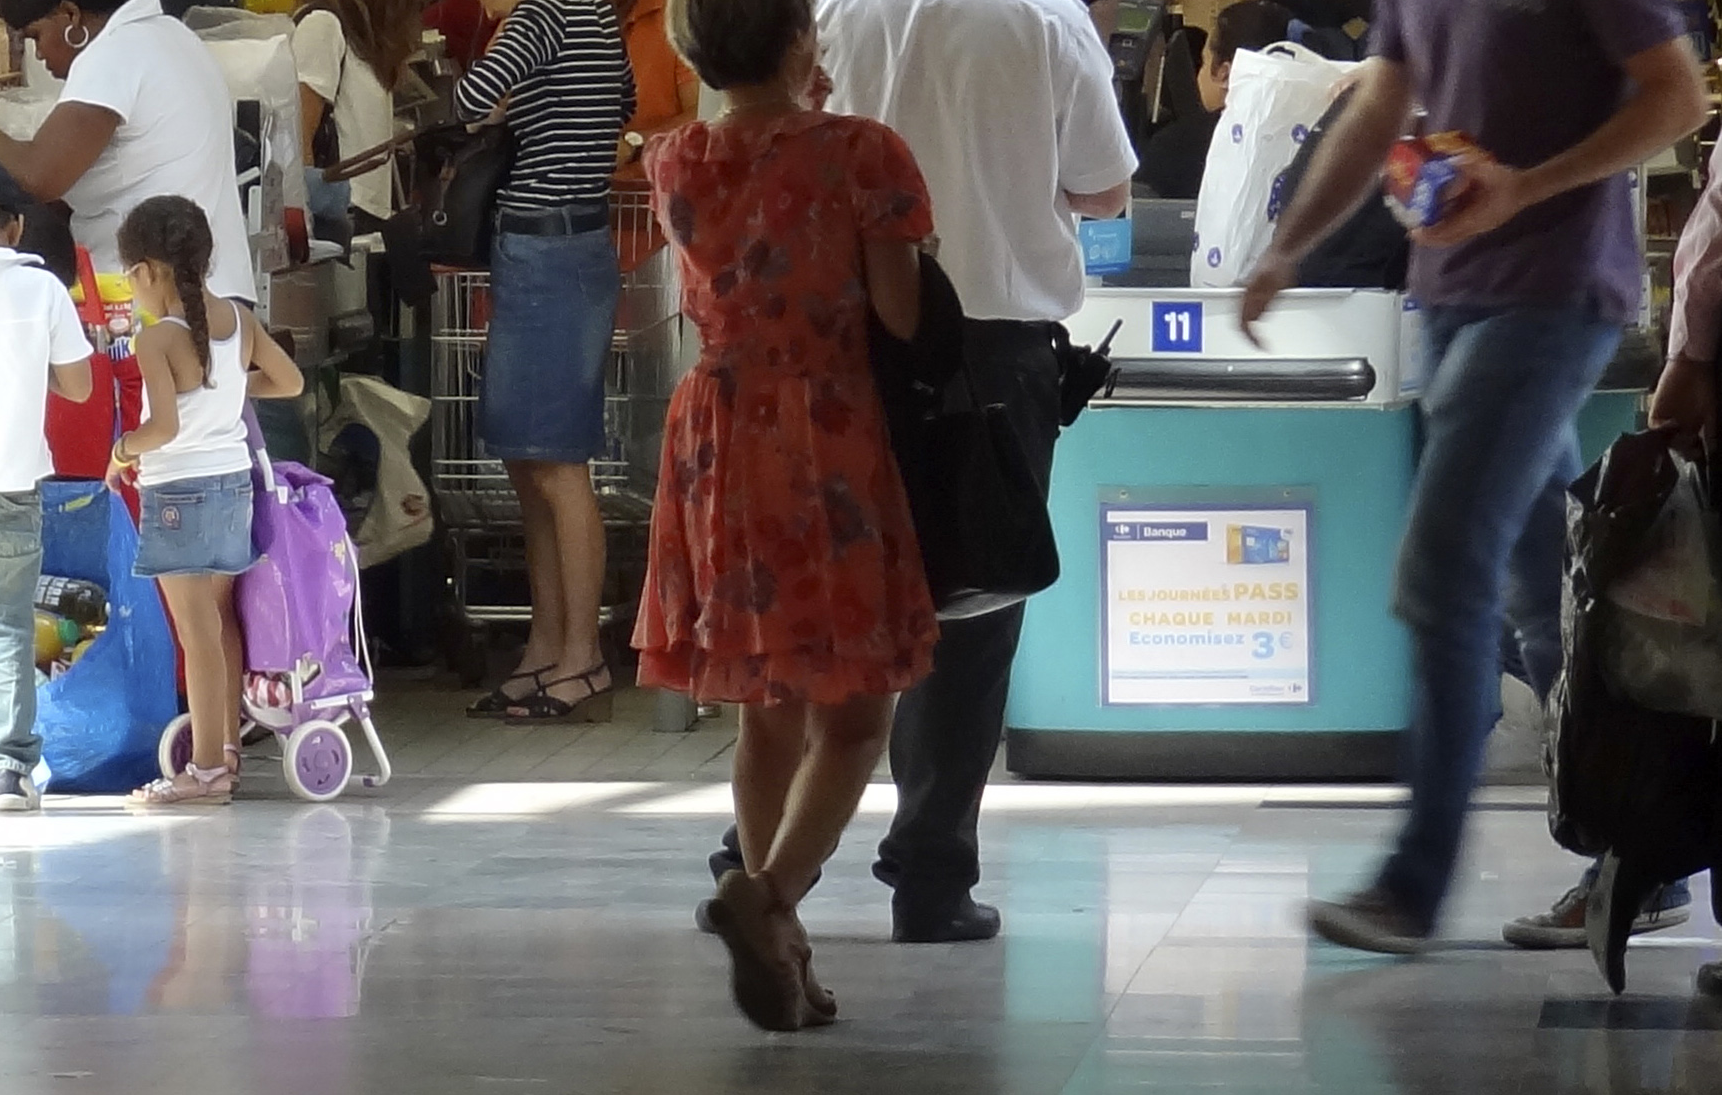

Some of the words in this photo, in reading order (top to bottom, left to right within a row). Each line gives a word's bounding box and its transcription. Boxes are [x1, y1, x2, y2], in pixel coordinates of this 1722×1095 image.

[1164, 311, 1190, 342] 11
[1143, 526, 1187, 538] Banque
[1118, 589, 1147, 602] LES
[1233, 582, 1299, 601] PASS
[1129, 611, 1214, 626] CHAQUE
[1227, 611, 1292, 626] MARDI
[1129, 630, 1245, 645] Economisez
